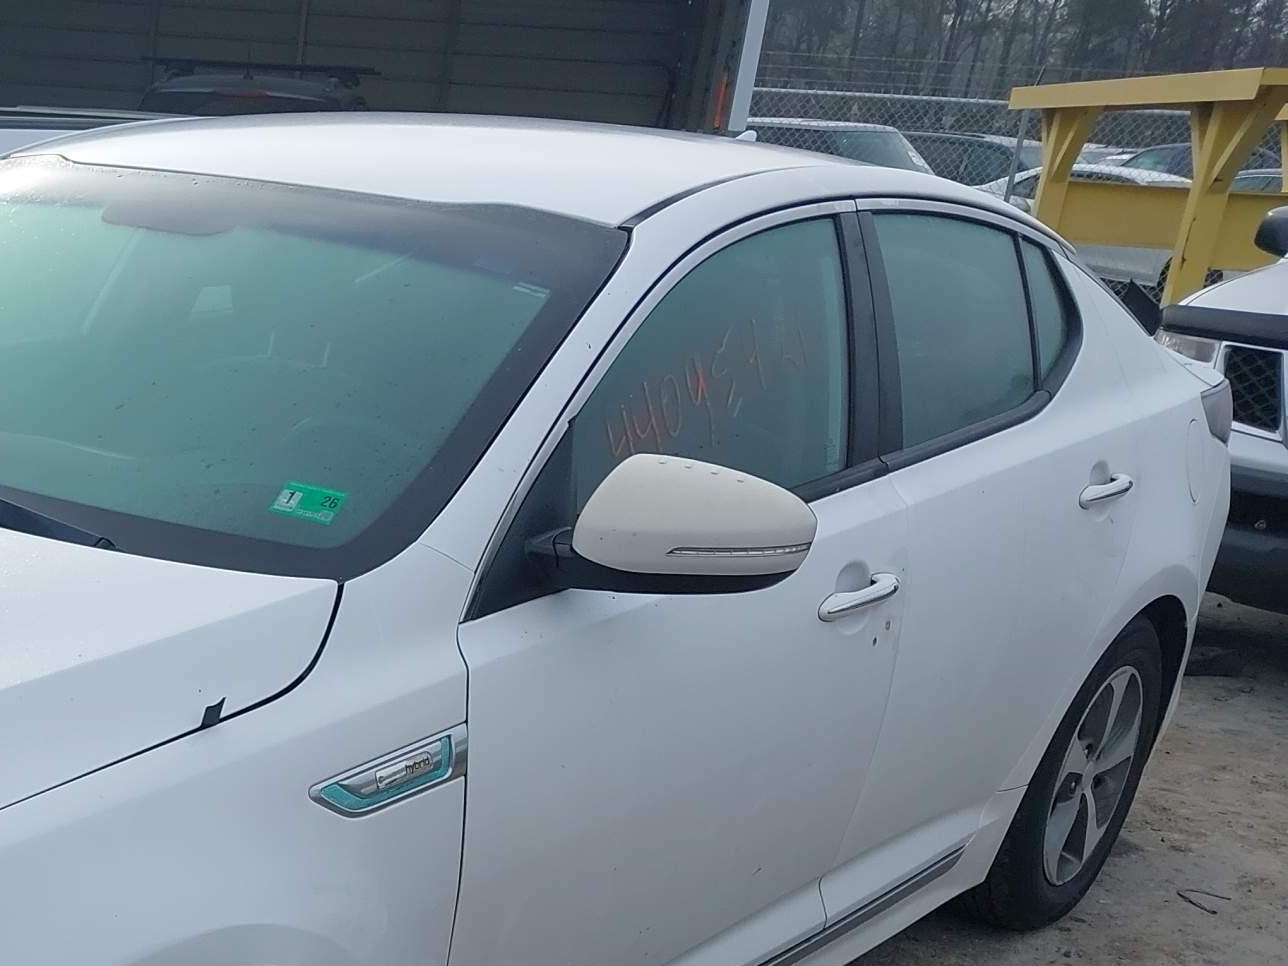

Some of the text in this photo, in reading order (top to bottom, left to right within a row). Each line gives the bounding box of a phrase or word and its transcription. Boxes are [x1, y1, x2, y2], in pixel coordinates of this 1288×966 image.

[286, 491, 340, 509] 1 26
[405, 756, 430, 776] hybrid
